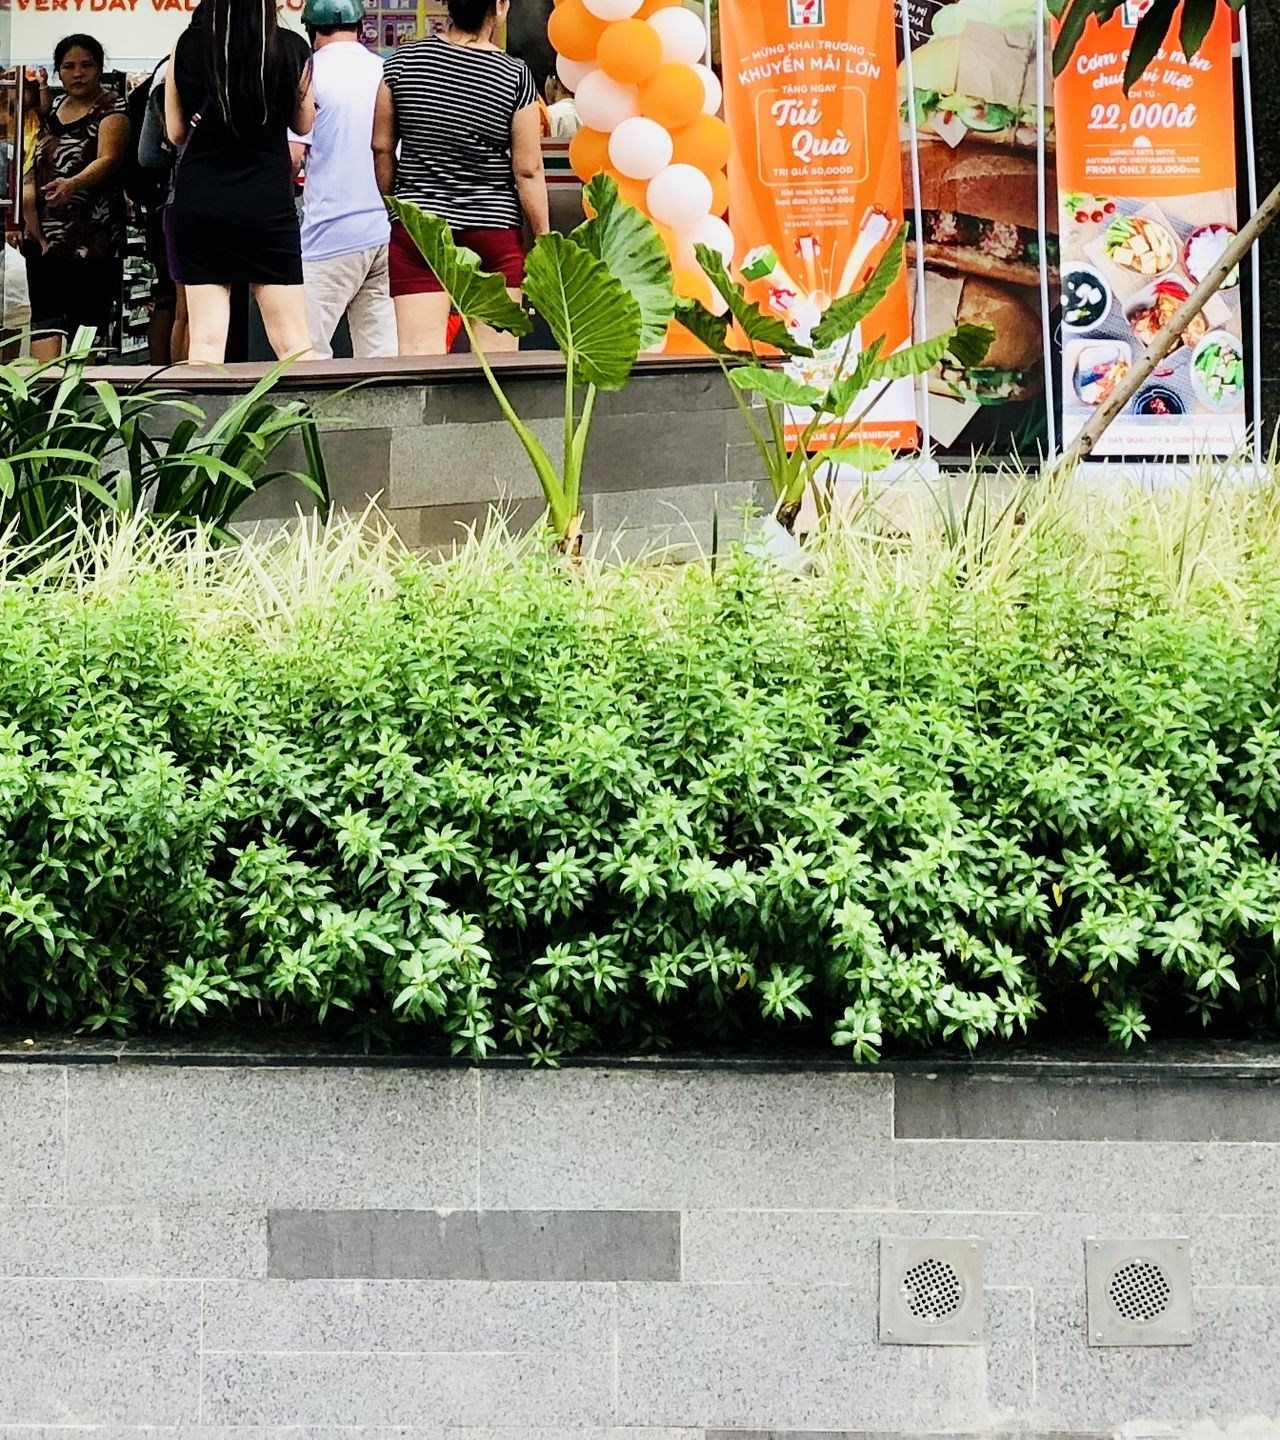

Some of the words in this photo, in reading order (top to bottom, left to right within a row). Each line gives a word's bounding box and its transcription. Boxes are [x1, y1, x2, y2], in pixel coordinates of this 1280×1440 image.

[752, 44, 785, 61] MỪNG
[788, 40, 815, 52] KHAI
[1076, 51, 1118, 75] Cơm
[738, 50, 805, 86] KHUYẾN
[845, 58, 881, 80] LỚN
[810, 83, 837, 93] NGAY
[770, 97, 823, 127] Túi
[1087, 102, 1198, 133] 22,000đ
[791, 128, 852, 164] Quà
[1085, 165, 1116, 175] FROM
[1118, 165, 1148, 175] ONLY
